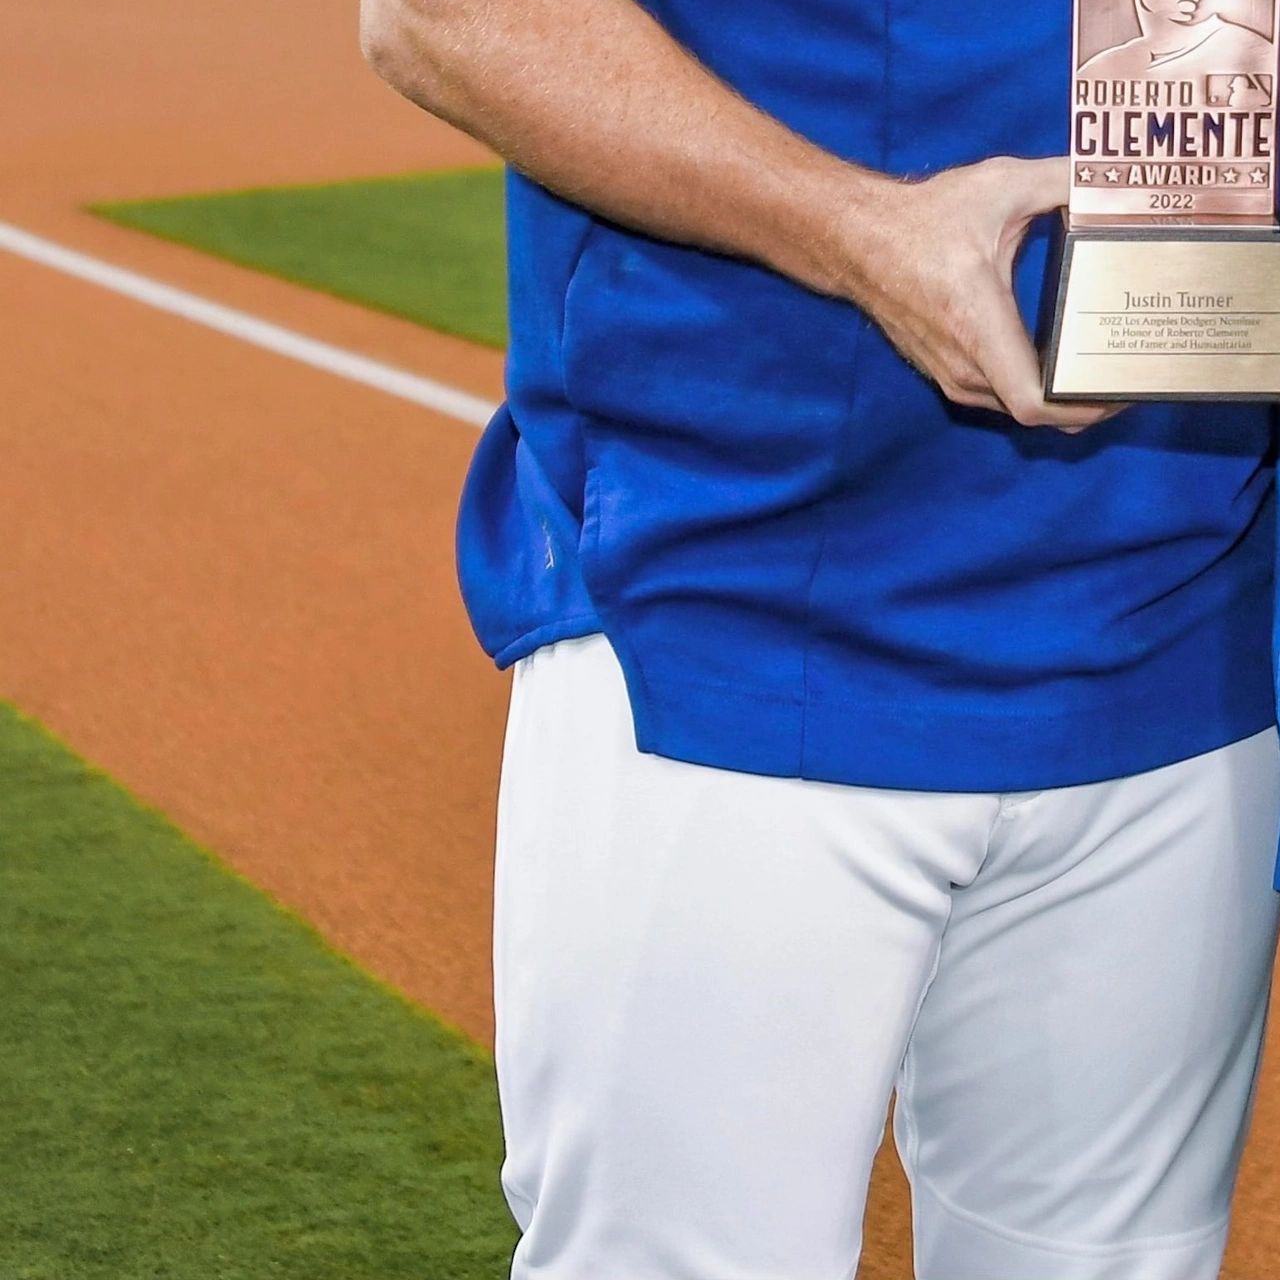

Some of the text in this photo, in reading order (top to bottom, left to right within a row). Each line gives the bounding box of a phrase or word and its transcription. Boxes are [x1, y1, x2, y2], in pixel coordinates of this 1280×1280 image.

[1075, 79, 1194, 107] ROBERTO
[1074, 111, 1272, 158] CLEMENTE
[1127, 164, 1217, 186] AWARD
[1150, 194, 1194, 210] 2022
[1123, 291, 1234, 310] Justin Turner
[1098, 316, 1123, 326] 2022
[1125, 316, 1141, 326] Los
[1142, 316, 1178, 327] Angeles
[1180, 316, 1217, 328] Dodgers
[1110, 328, 1249, 337] In Honor of Roberto Clemente
[1107, 340, 1252, 349] Hall of Famer and Humanitarian
